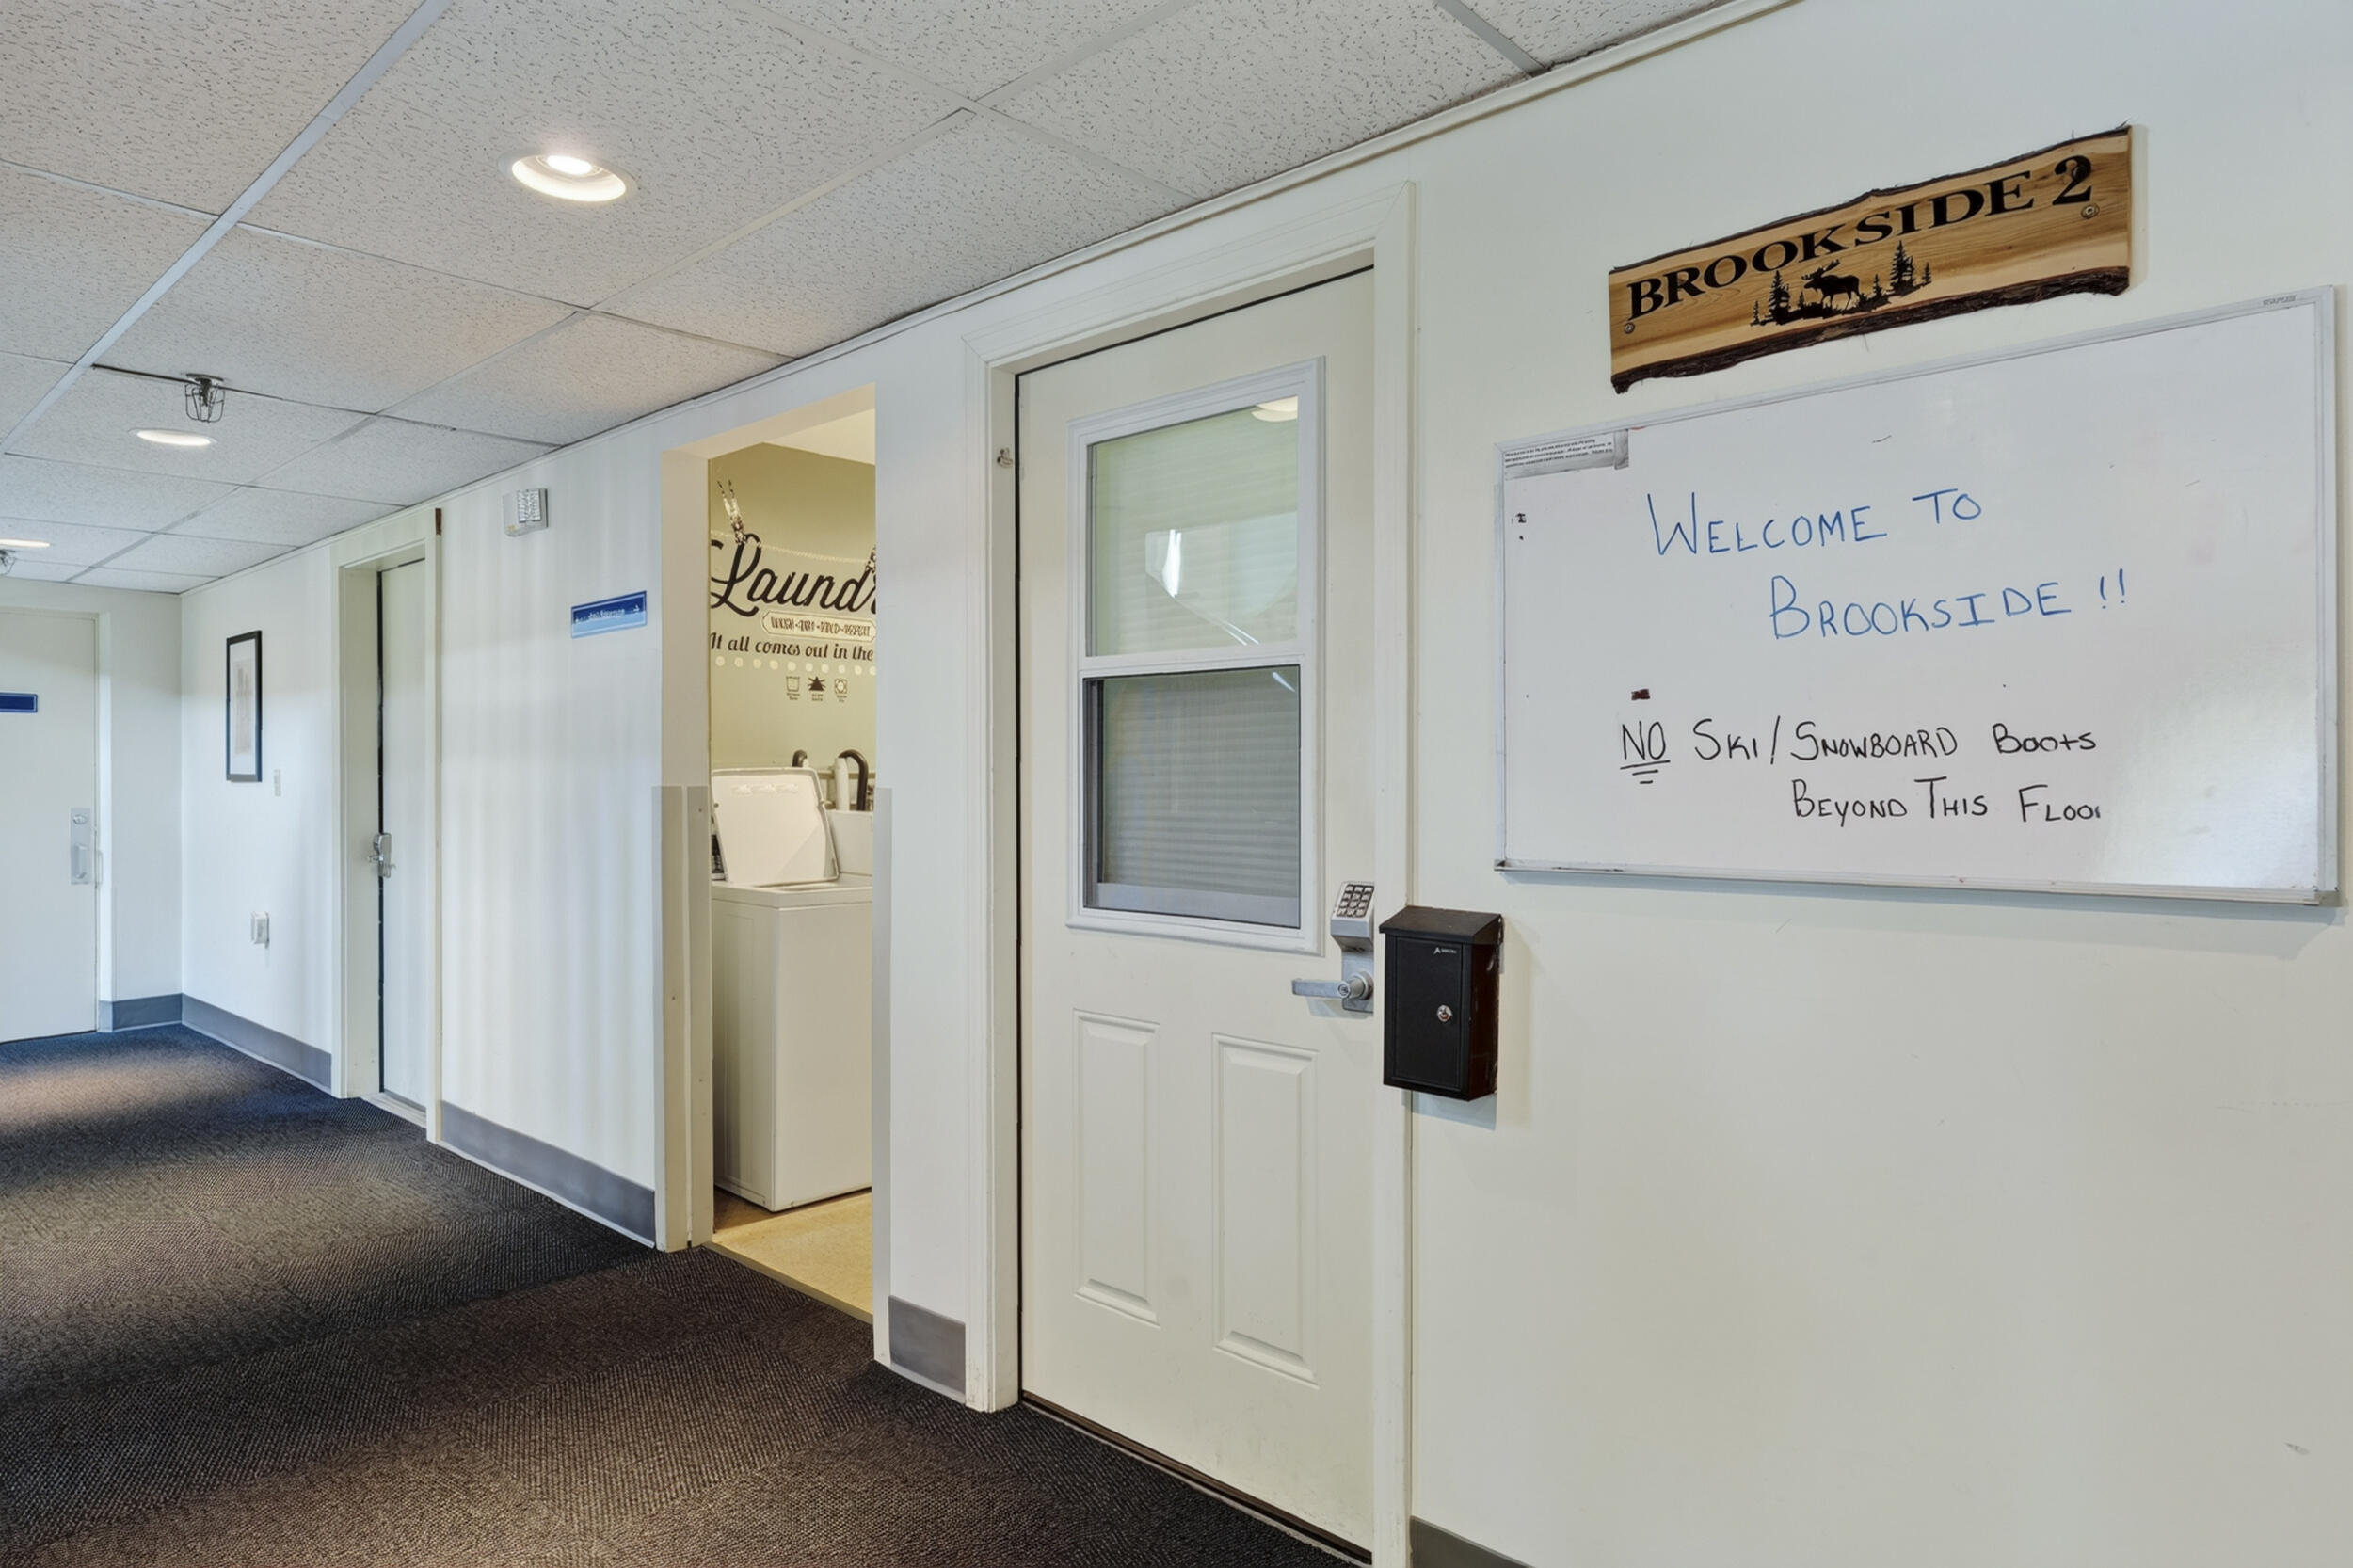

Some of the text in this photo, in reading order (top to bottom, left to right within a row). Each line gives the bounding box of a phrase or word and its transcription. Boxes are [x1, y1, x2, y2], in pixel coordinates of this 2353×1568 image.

[1628, 155, 2092, 320] BROOKSIDE 2
[1912, 488, 1982, 524] TO
[728, 635, 750, 653] all
[755, 641, 801, 657] comes
[805, 644, 829, 658] out
[833, 643, 848, 660] in
[852, 646, 874, 661] the
[1622, 721, 1667, 760] NO
